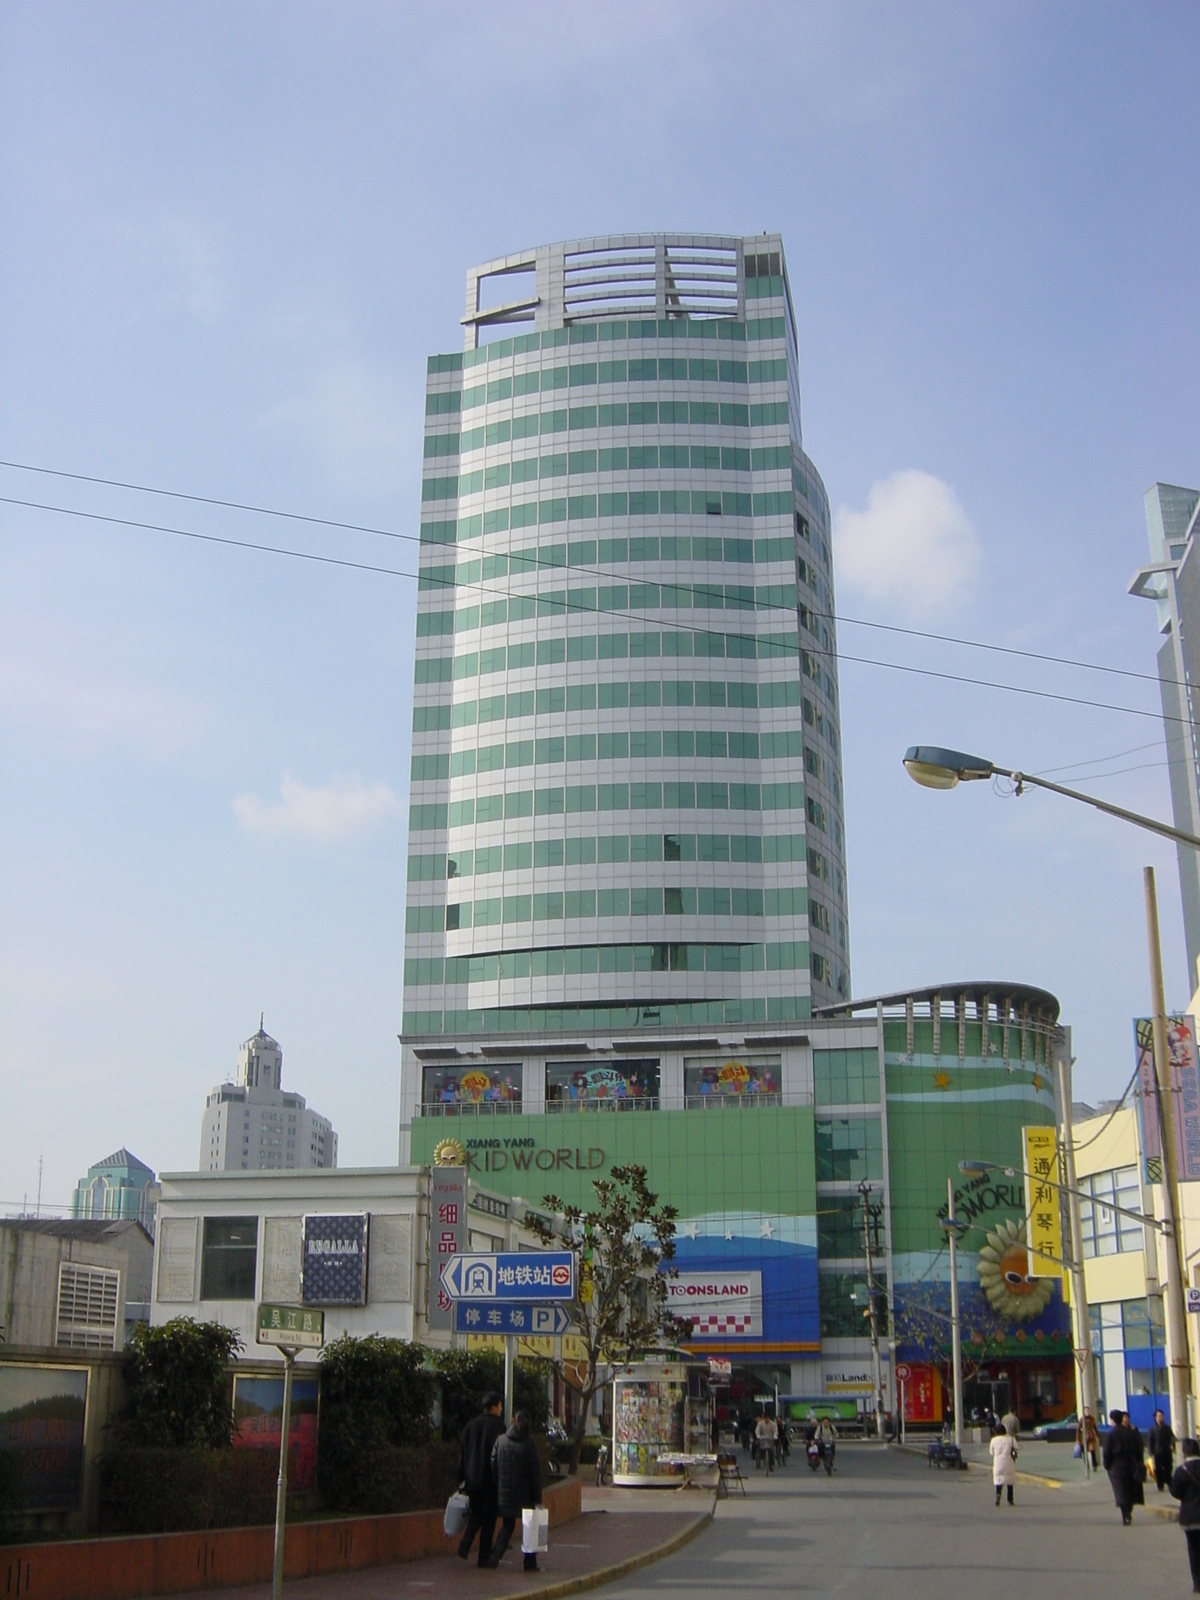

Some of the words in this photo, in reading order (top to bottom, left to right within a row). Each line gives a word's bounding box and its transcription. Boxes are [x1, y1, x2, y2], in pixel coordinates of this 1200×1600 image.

[1181, 1066, 1198, 1113] SEGA
[466, 1138, 500, 1149] XIANG
[503, 1137, 535, 1148] YANG
[1184, 1117, 1200, 1175] WORLD
[465, 1148, 605, 1172] KIDWORLD
[962, 1174, 991, 1193] YANG
[1034, 1157, 1055, 1259] 通利琴行
[437, 1202, 458, 1313] 细品场
[497, 1264, 551, 1286] 地铁站
[668, 1284, 749, 1296] TOONSLAND
[271, 1309, 312, 1331] 吴江路
[465, 1308, 525, 1327] 停车场
[537, 1309, 550, 1329] P
